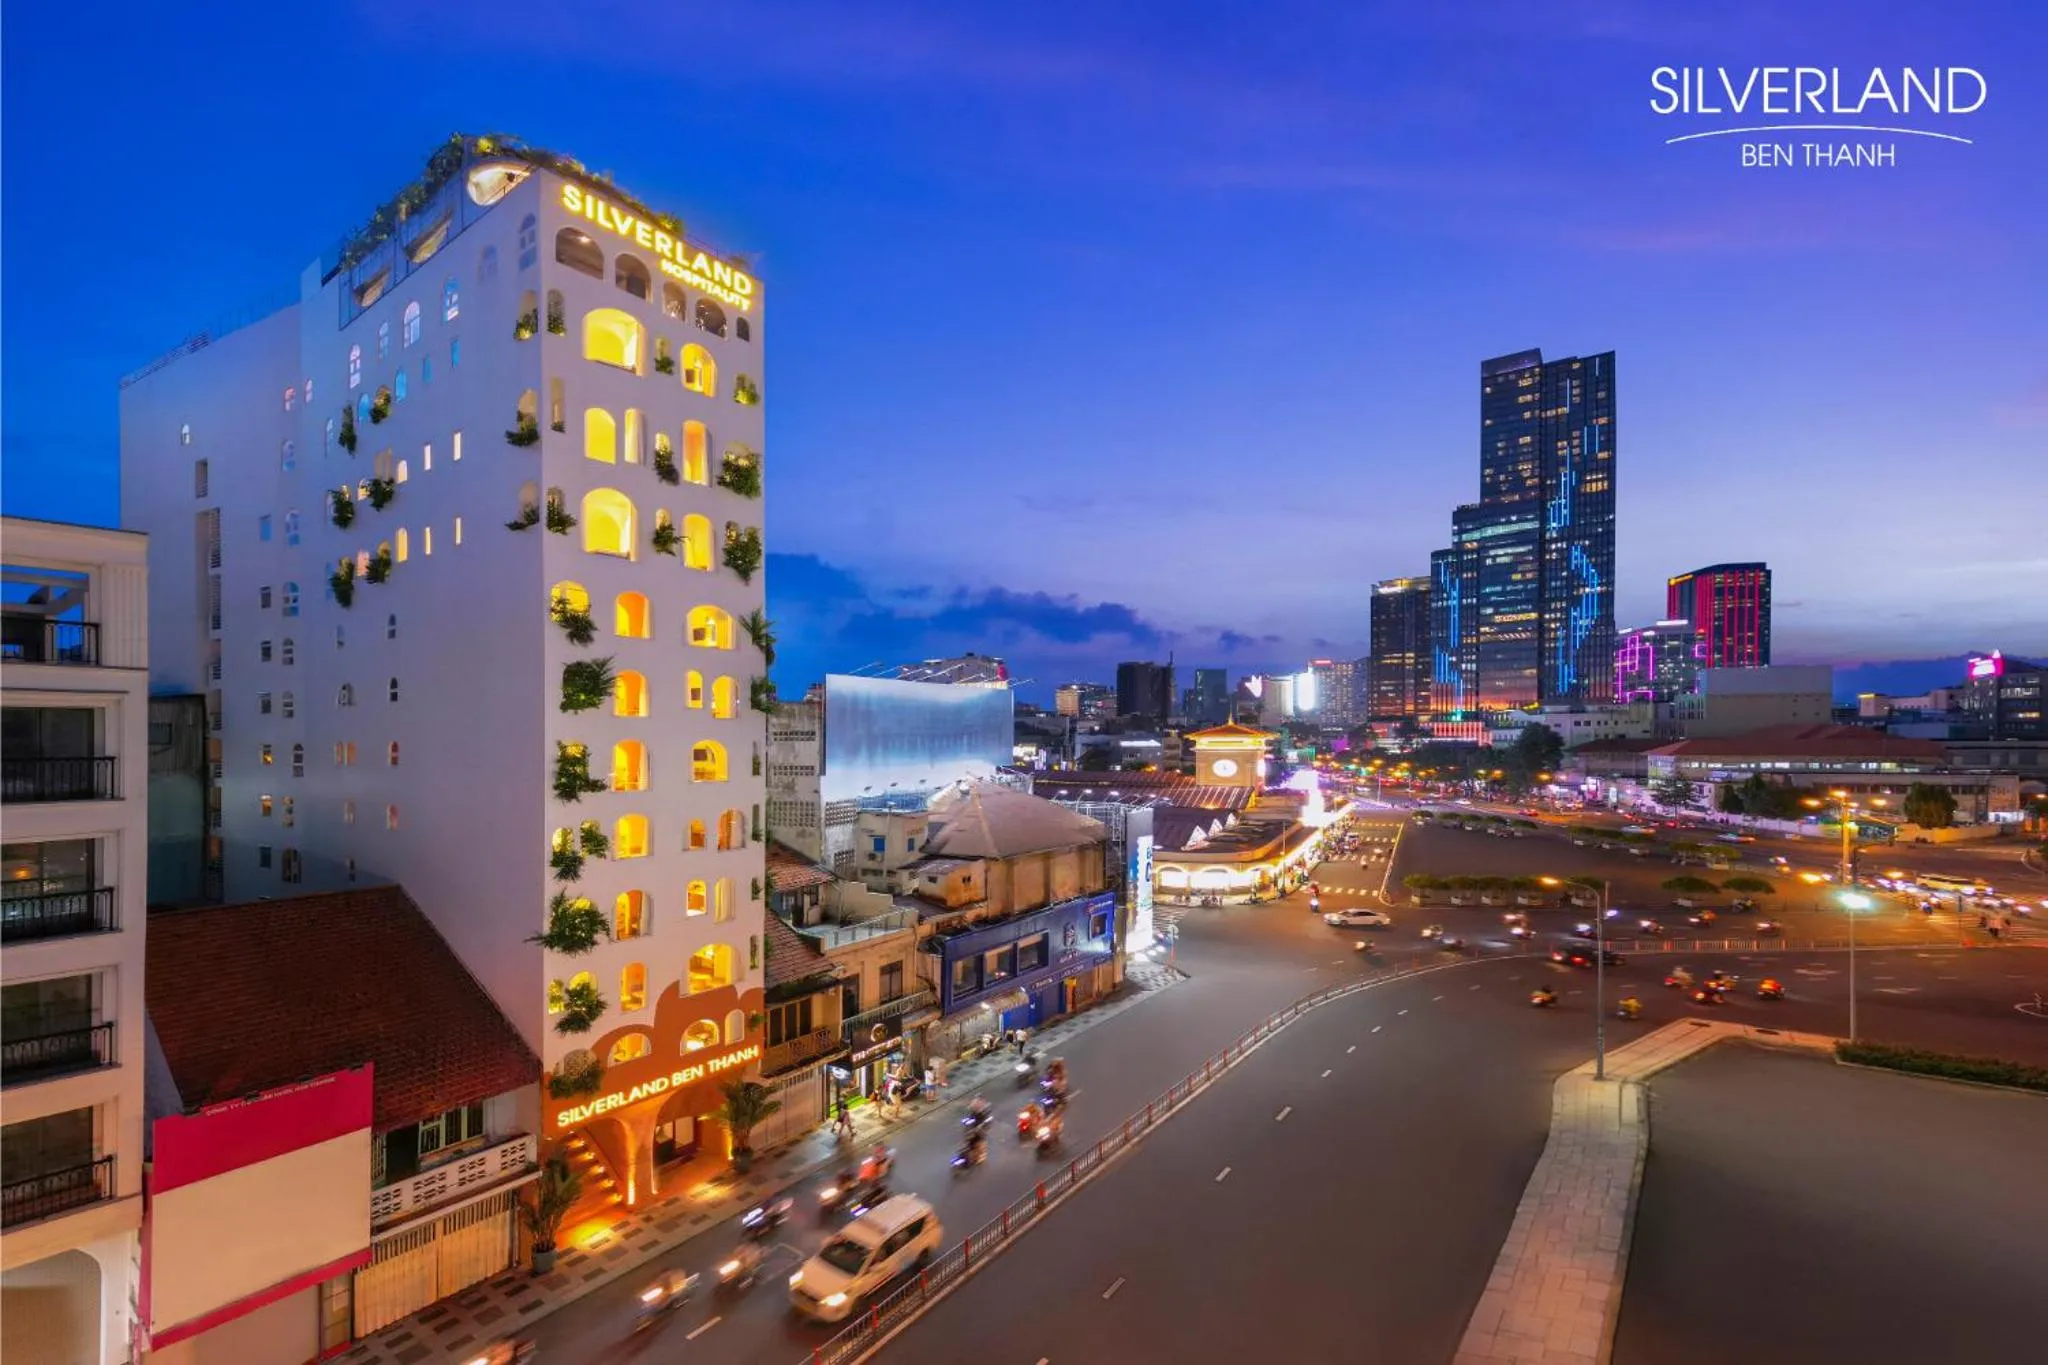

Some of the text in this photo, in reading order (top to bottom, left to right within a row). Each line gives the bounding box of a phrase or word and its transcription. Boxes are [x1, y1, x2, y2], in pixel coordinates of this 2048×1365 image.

[563, 184, 753, 296] SILVERLAND
[557, 1044, 760, 1127] SILVERLAND BEN THANH
